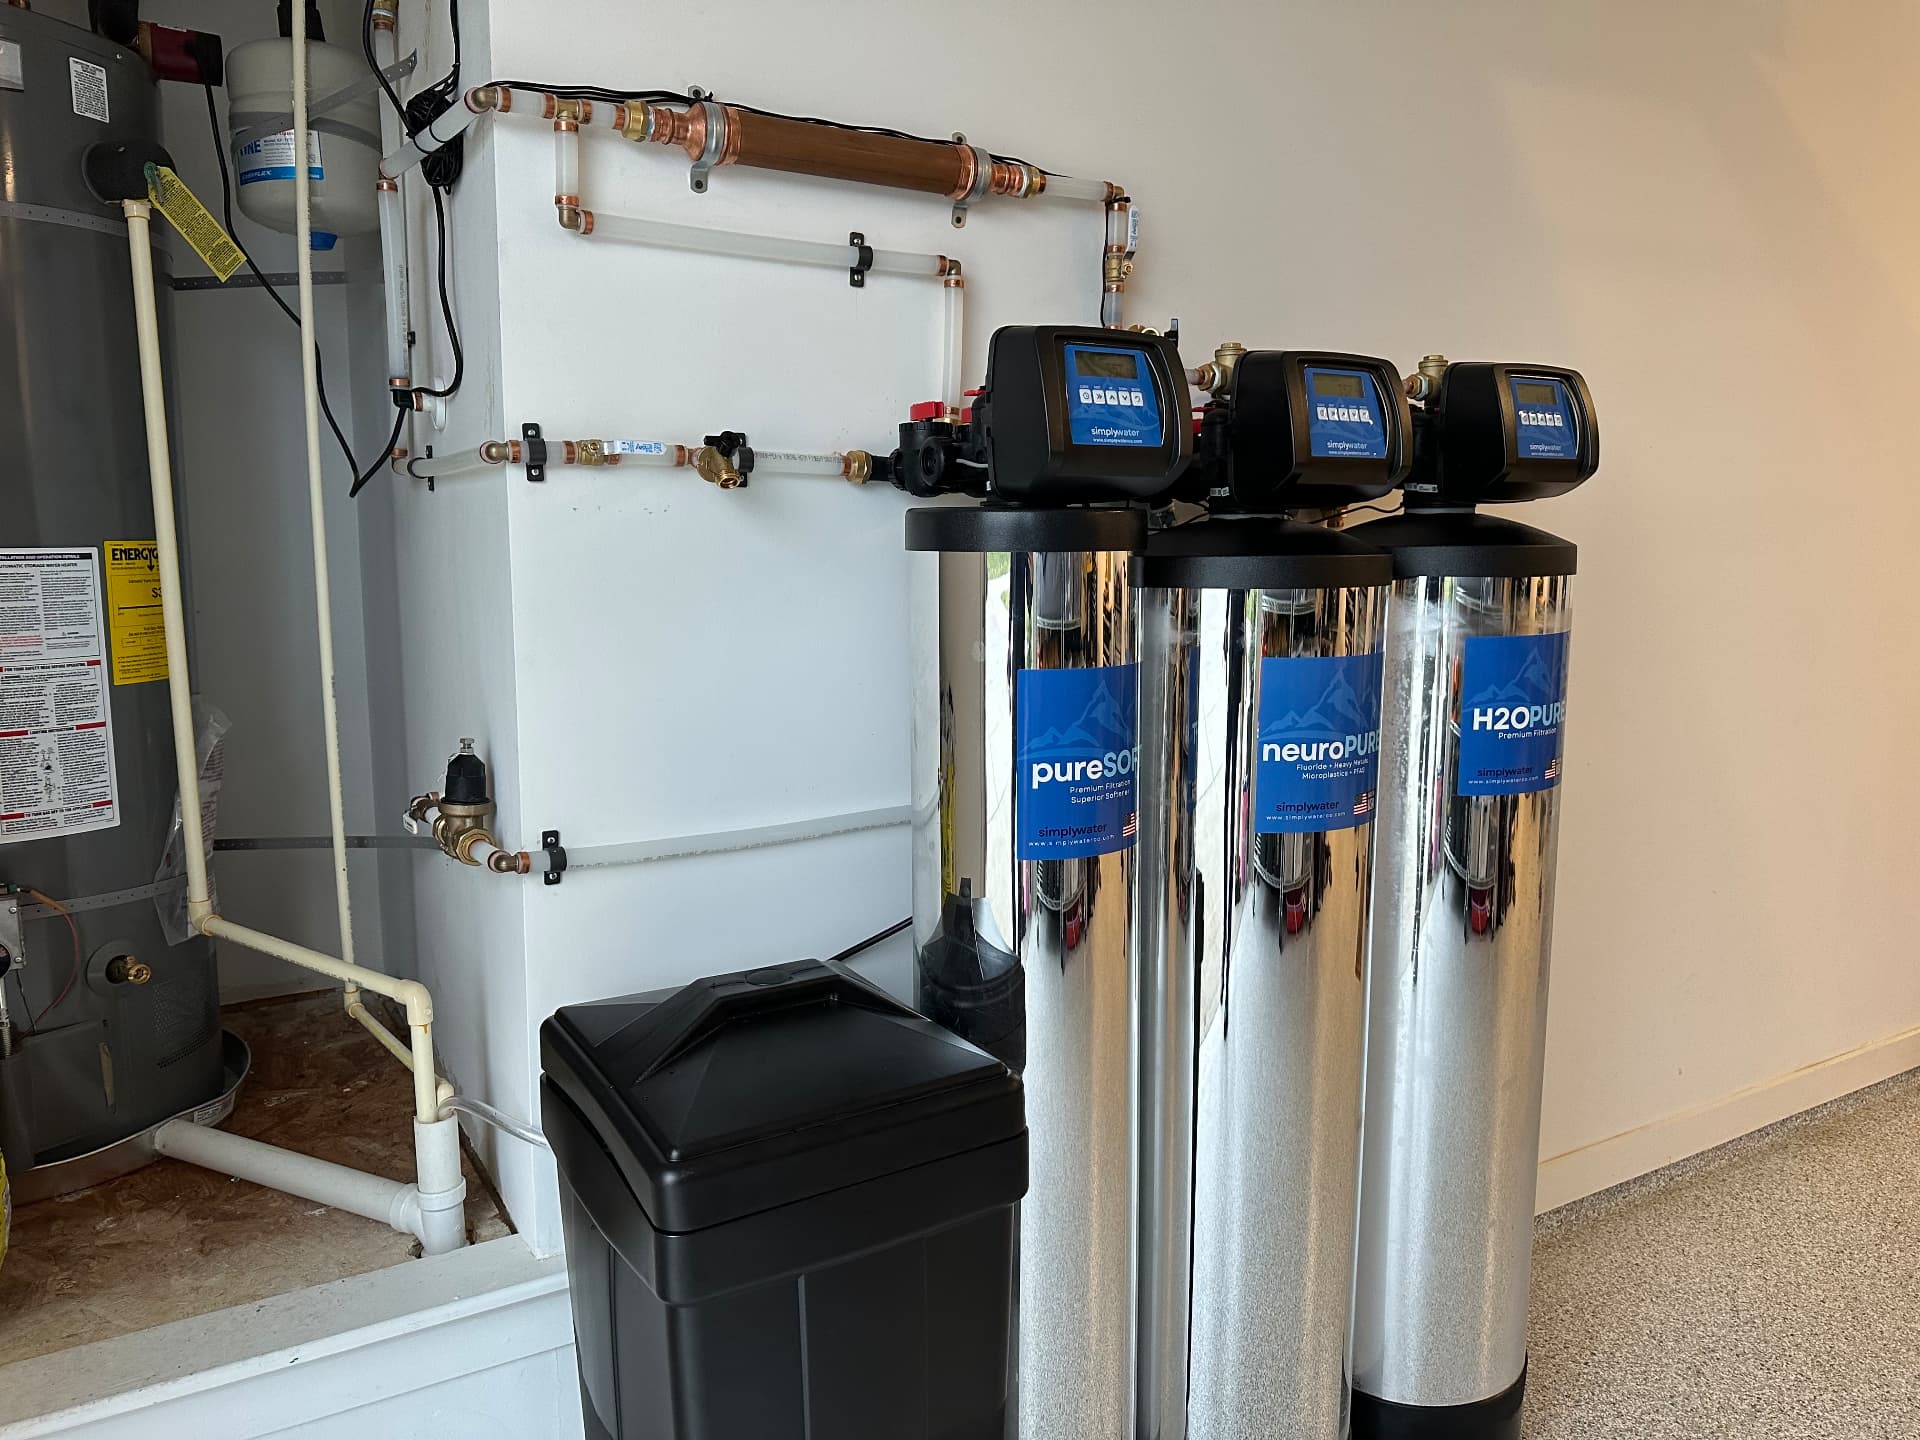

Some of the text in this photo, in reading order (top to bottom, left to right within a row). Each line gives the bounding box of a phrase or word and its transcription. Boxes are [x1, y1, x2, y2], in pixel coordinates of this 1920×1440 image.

[1091, 426, 1139, 437] simplywater
[1327, 440, 1367, 450] simplywater
[1498, 727, 1557, 739] Premium Filtration
[1296, 763, 1327, 771] Fluoride
[1333, 760, 1352, 769] Heavy
[1302, 771, 1348, 780] Microplastics
[1477, 767, 1533, 777] simplywater
[1070, 780, 1130, 793] Premium Filtration
[1071, 789, 1130, 804] Superior Softener
[1276, 801, 1339, 814] simplywater
[1038, 824, 1107, 838] simplywater
